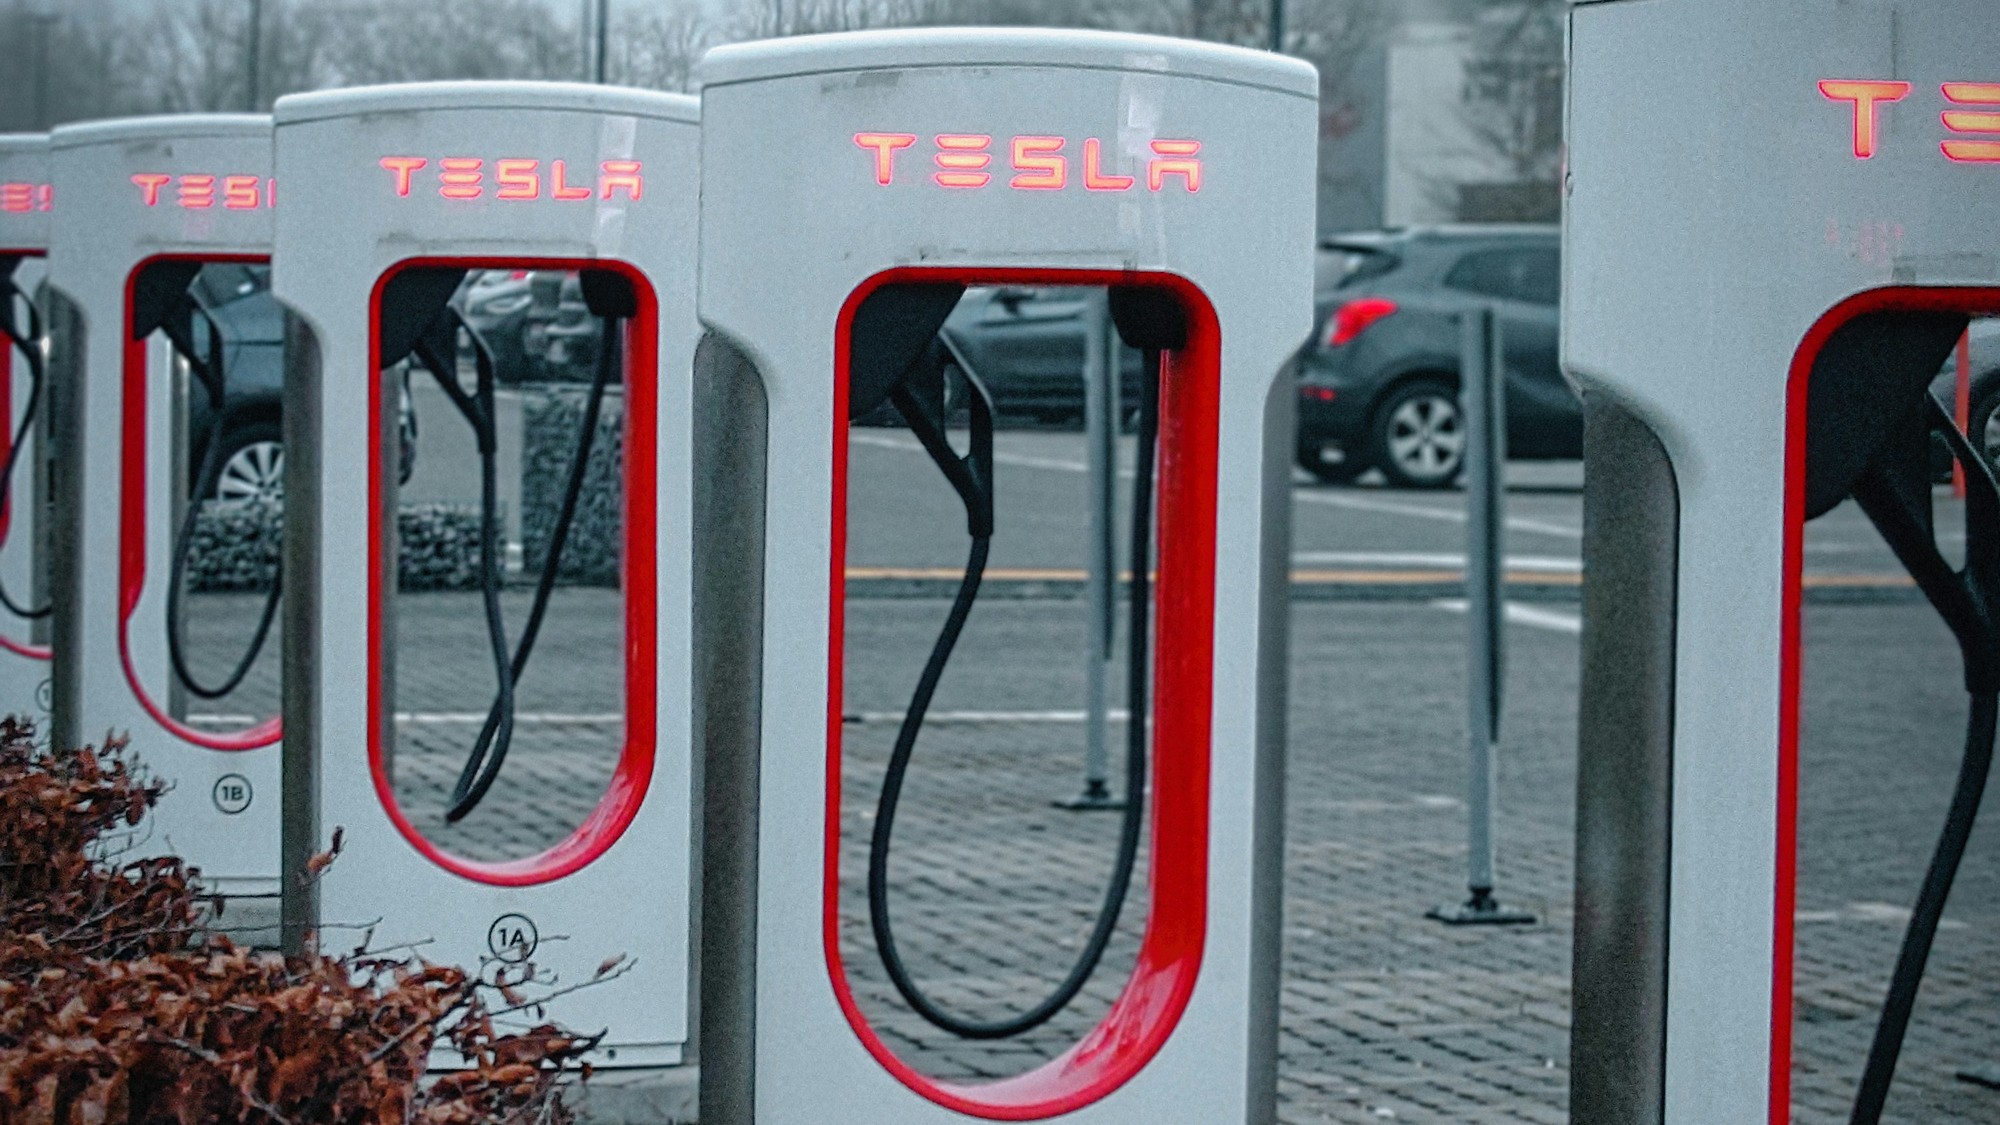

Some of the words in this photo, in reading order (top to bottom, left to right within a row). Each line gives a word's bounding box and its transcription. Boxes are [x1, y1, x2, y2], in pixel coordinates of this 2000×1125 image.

[379, 156, 643, 201] TESLA
[853, 132, 1202, 193] TESLA
[131, 173, 276, 210] TES
[222, 786, 244, 800] 1B
[499, 928, 527, 946] 1A
